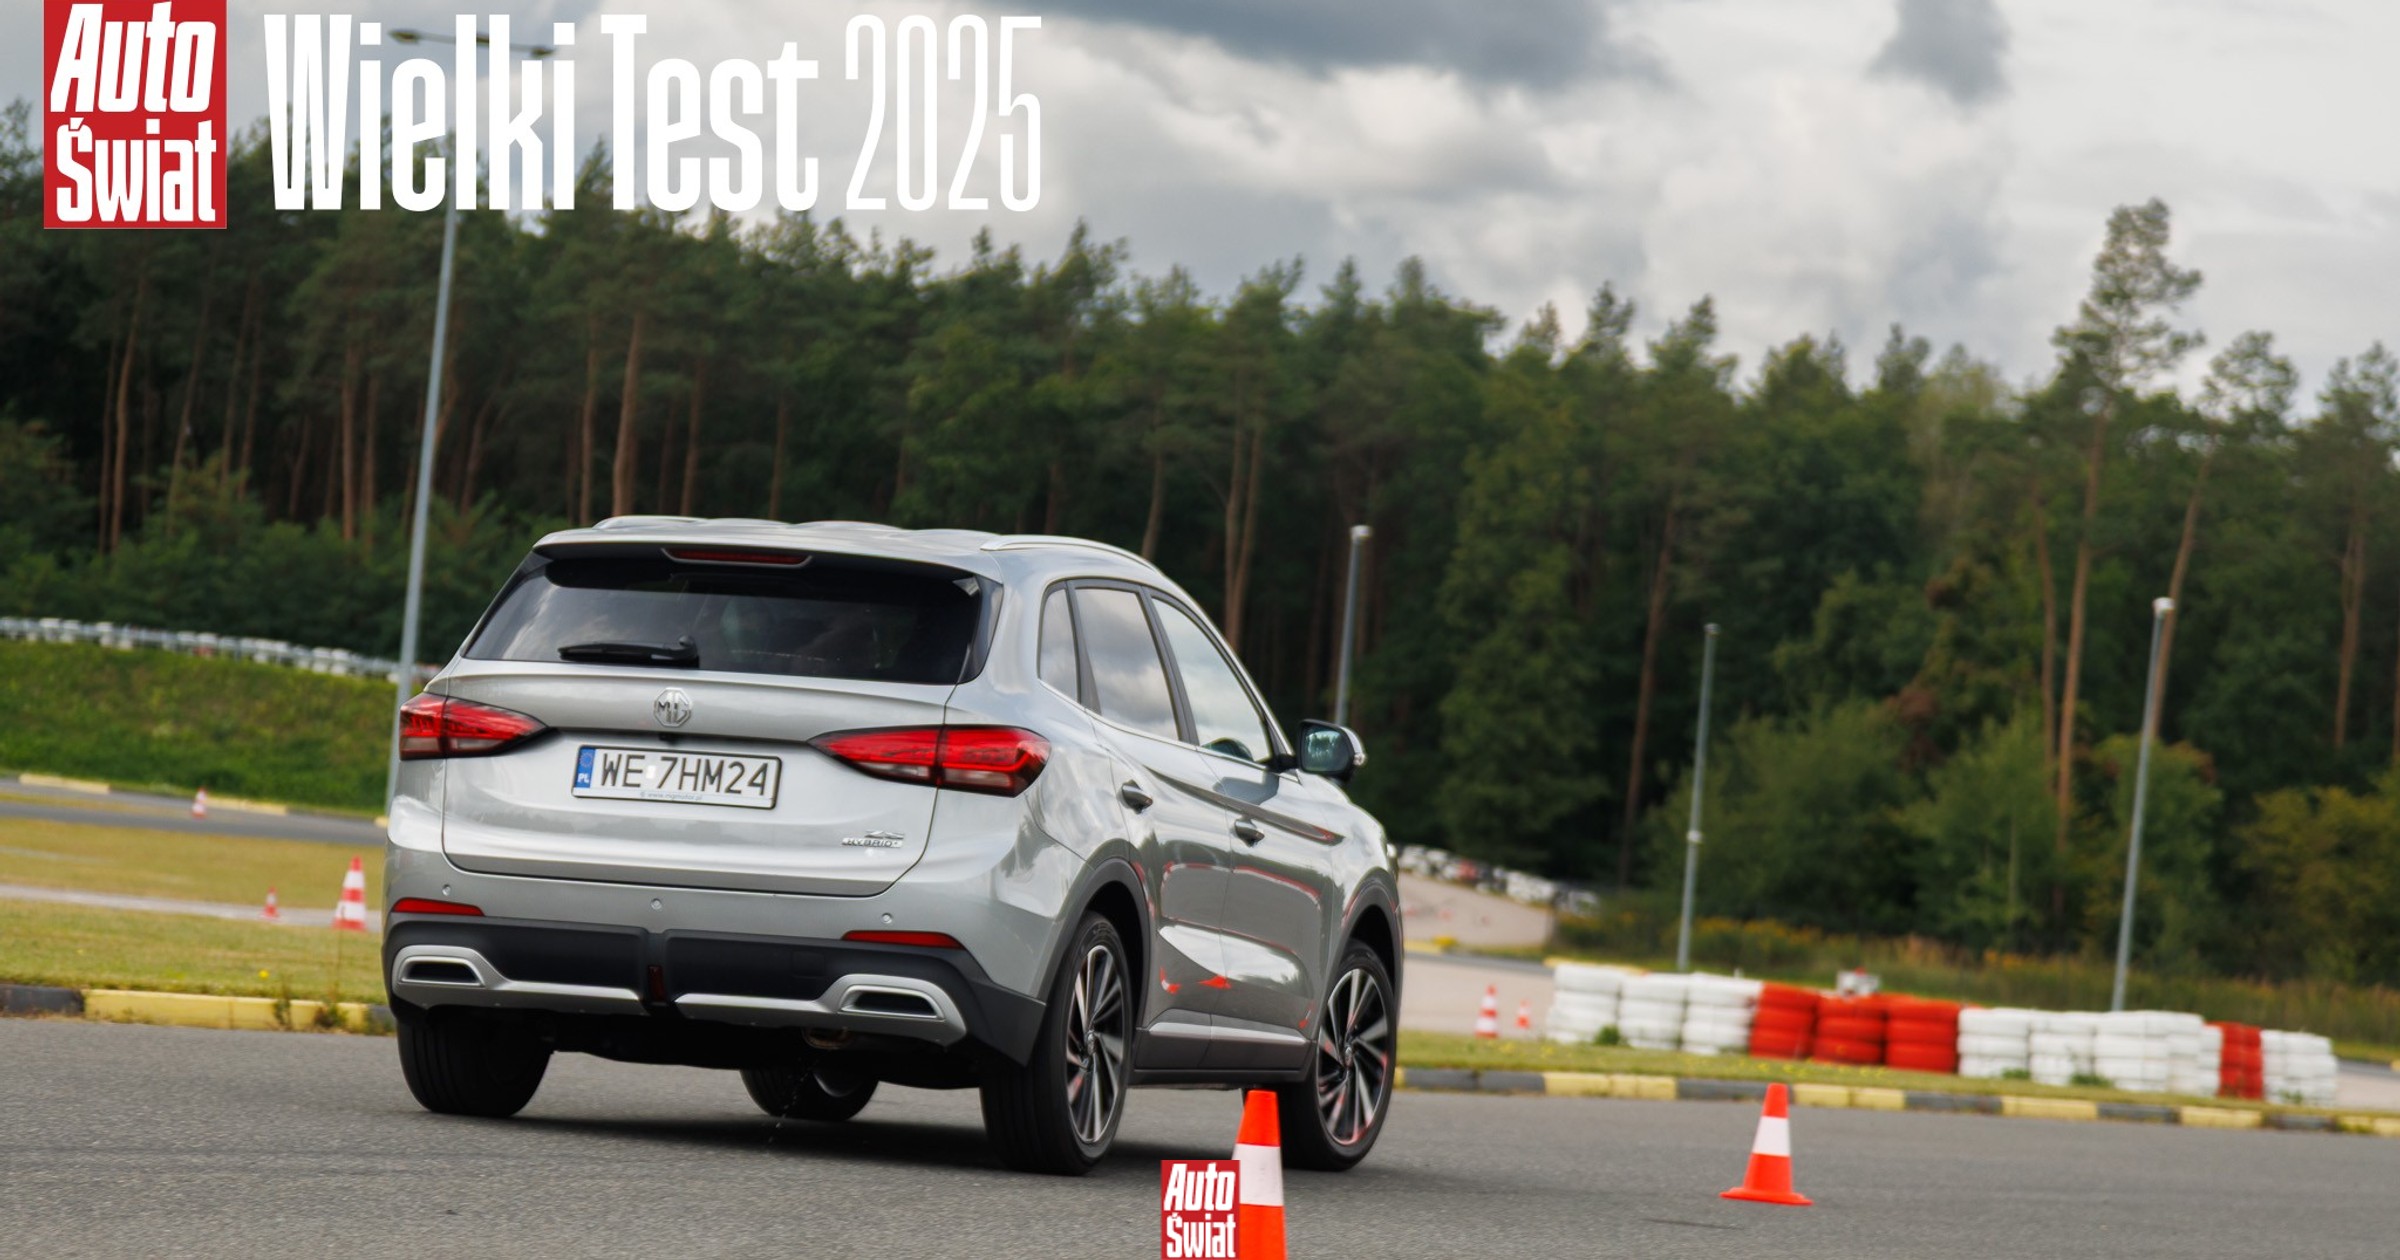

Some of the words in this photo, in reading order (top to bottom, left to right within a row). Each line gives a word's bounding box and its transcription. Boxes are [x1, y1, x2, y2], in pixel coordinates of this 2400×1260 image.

[655, 689, 693, 727] MG
[577, 772, 591, 784] PL
[601, 753, 645, 788] WE
[657, 756, 768, 796] 7HM24
